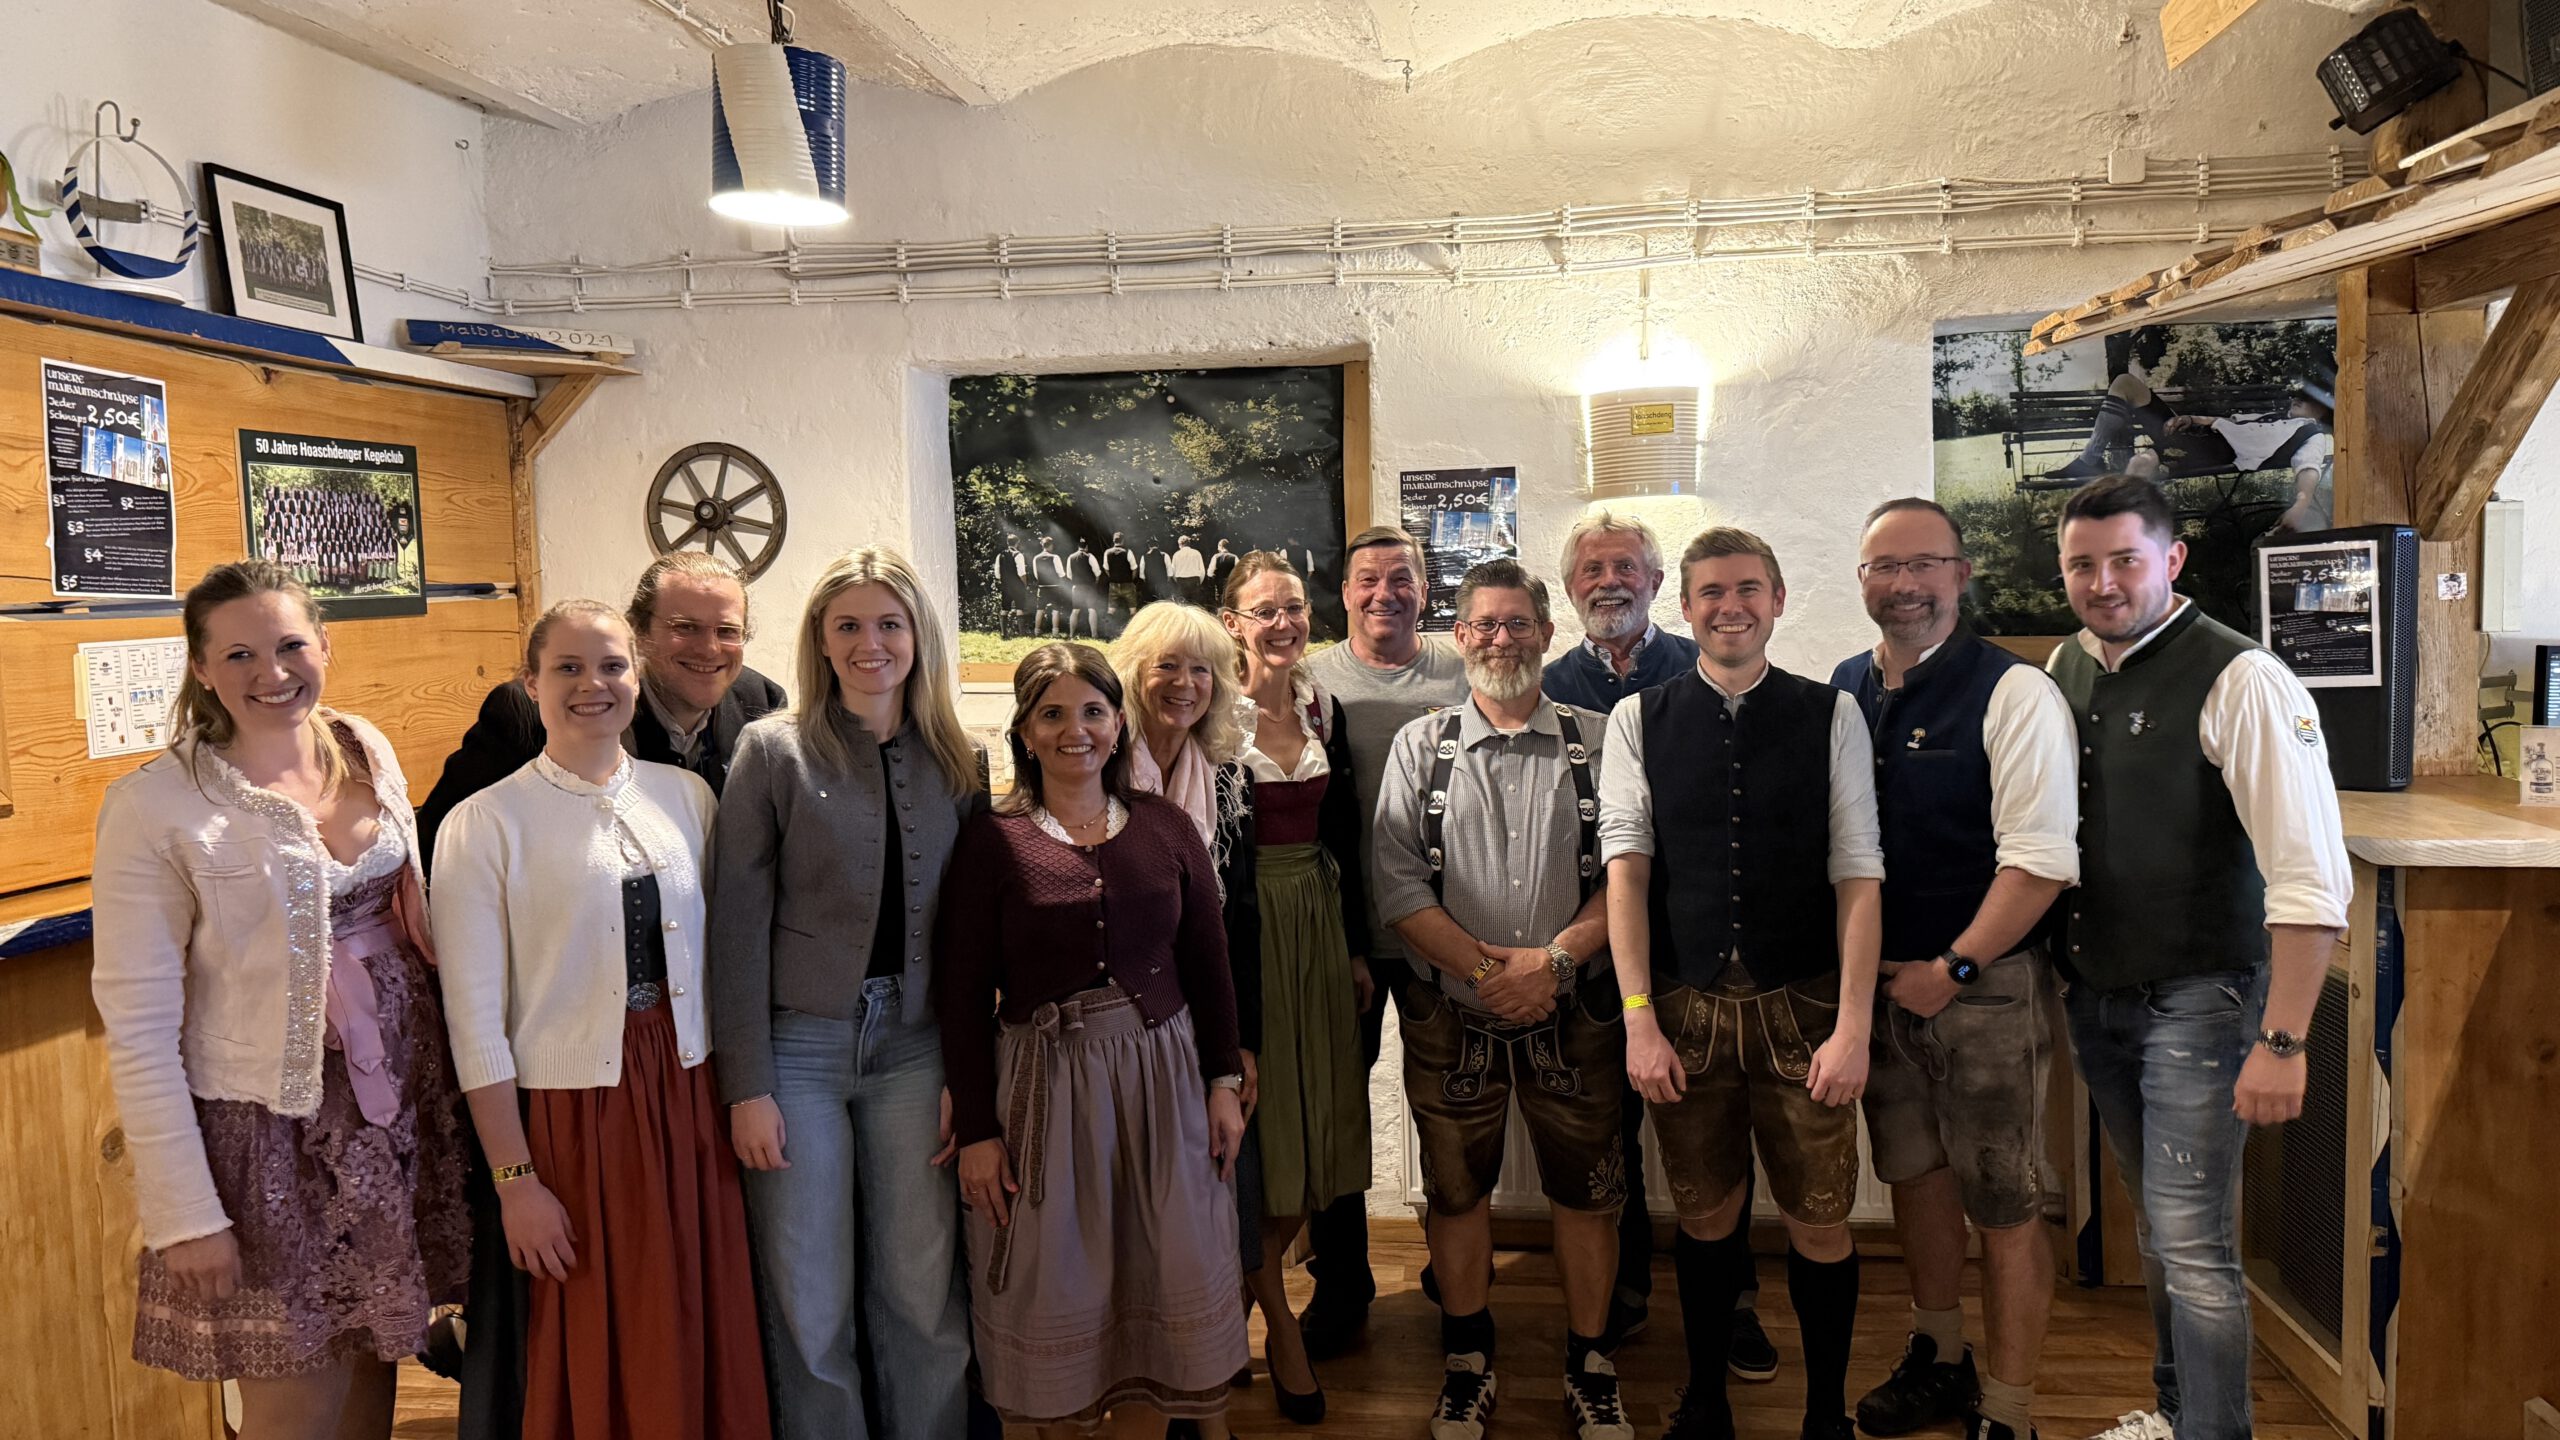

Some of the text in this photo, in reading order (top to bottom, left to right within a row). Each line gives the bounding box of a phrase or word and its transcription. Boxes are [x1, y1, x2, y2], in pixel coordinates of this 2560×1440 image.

[440, 323, 540, 340] Maibaum
[48, 396, 77, 409] Jeder
[48, 409, 88, 428] Schnaps
[87, 404, 142, 430] 2,50€
[255, 438, 404, 465] 50 Jahre Hoaschdenger Kegelclub
[1402, 492, 1428, 501] Jeder
[1438, 492, 1490, 511] 2,50€
